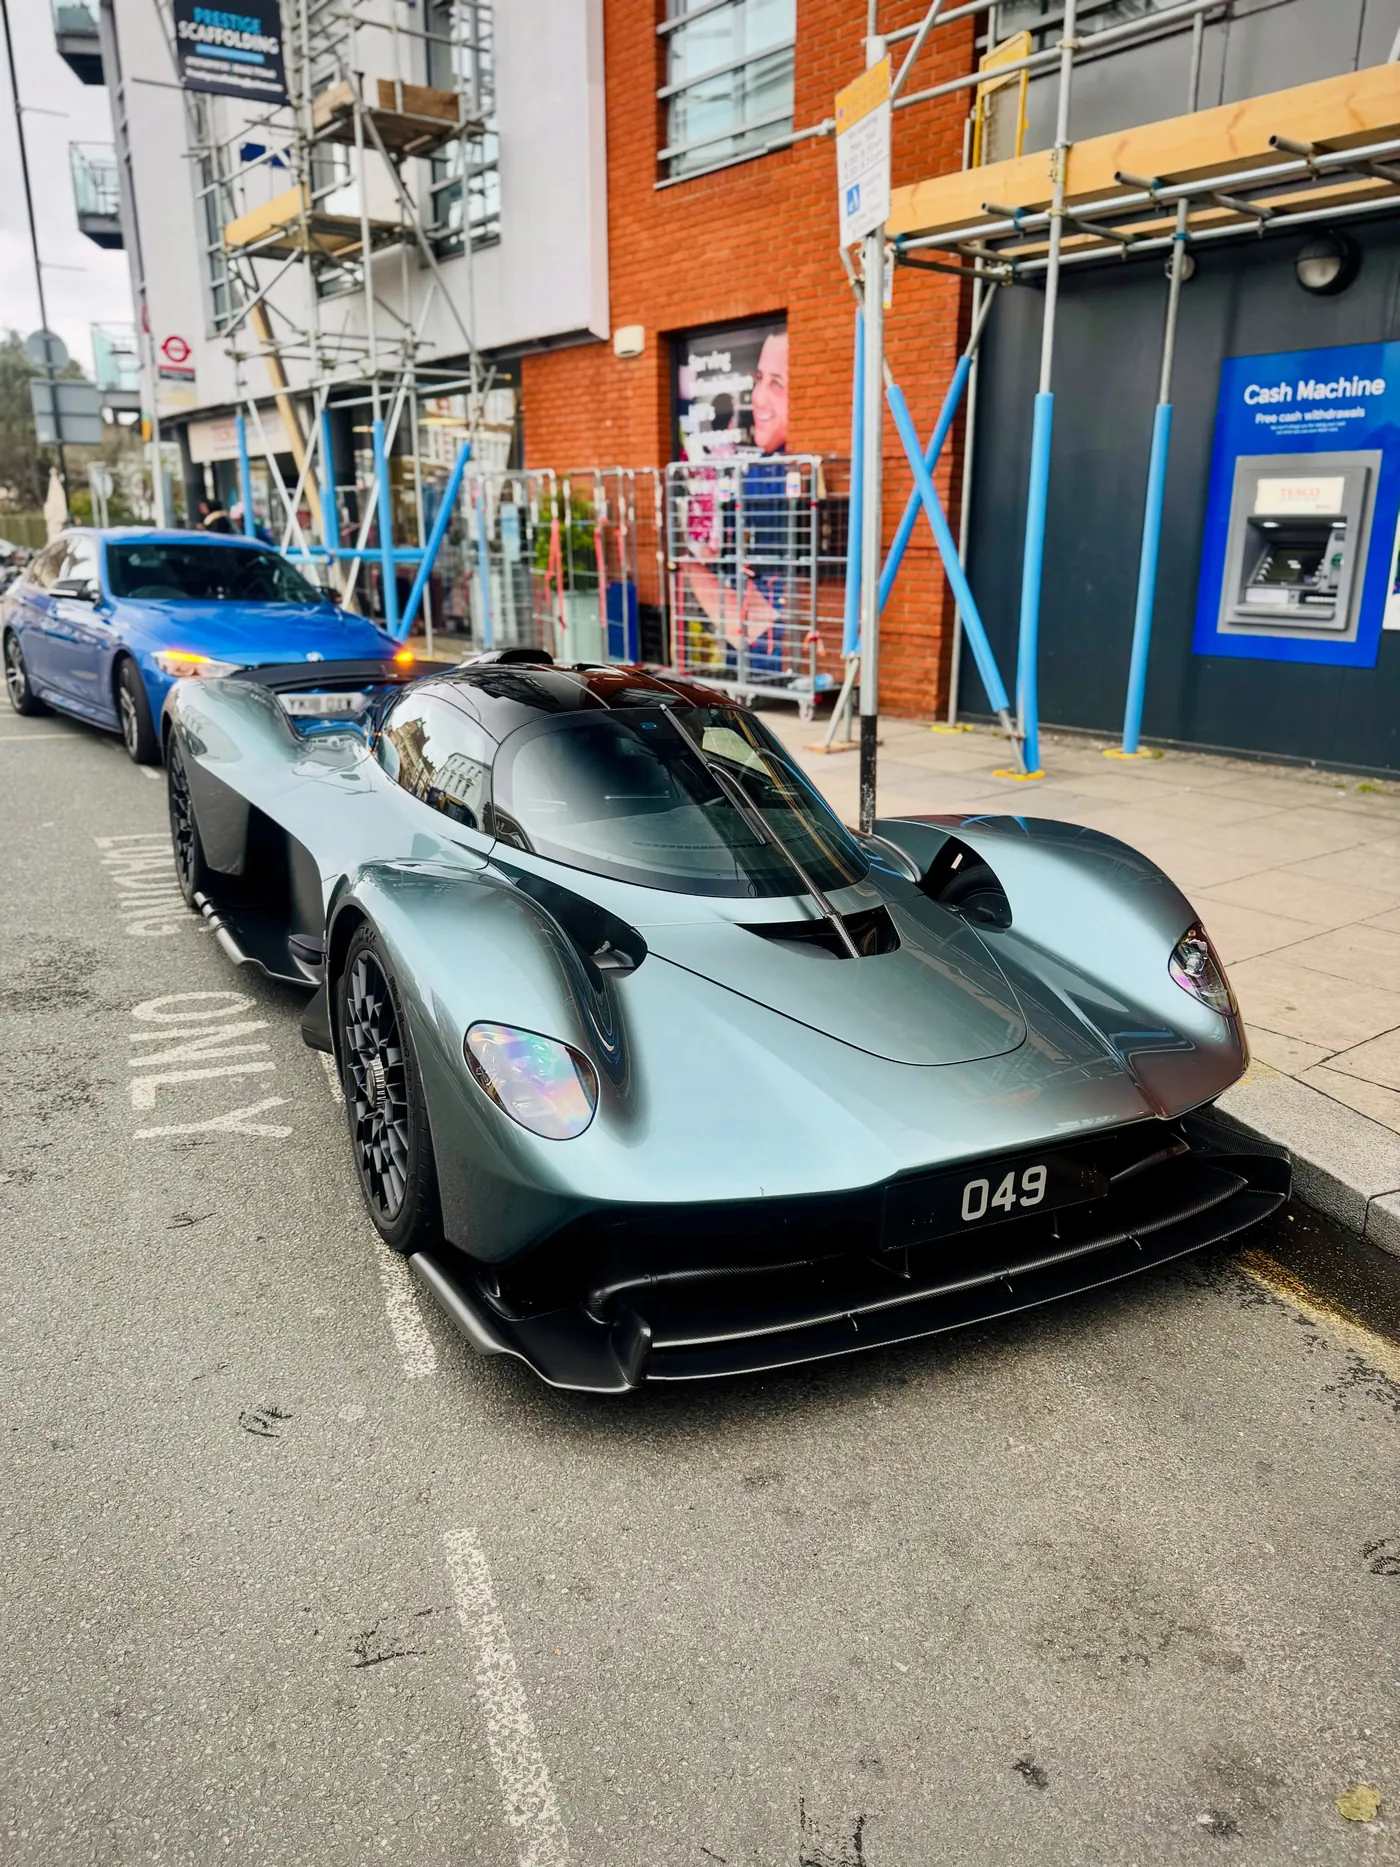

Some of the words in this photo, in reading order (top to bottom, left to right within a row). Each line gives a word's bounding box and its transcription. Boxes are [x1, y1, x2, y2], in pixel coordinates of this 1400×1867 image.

[193, 6, 261, 35] PRESTIGE
[178, 20, 279, 55] SCAFFOLDING
[1244, 382, 1292, 405] Cash
[1297, 375, 1386, 401] Machine
[1255, 412, 1277, 424] Free
[1279, 411, 1302, 423] cash
[1304, 406, 1365, 421] withdrawals
[1281, 487, 1321, 498] TESCO
[127, 991, 294, 1140] ONLY
[961, 1165, 1047, 1222] 049
